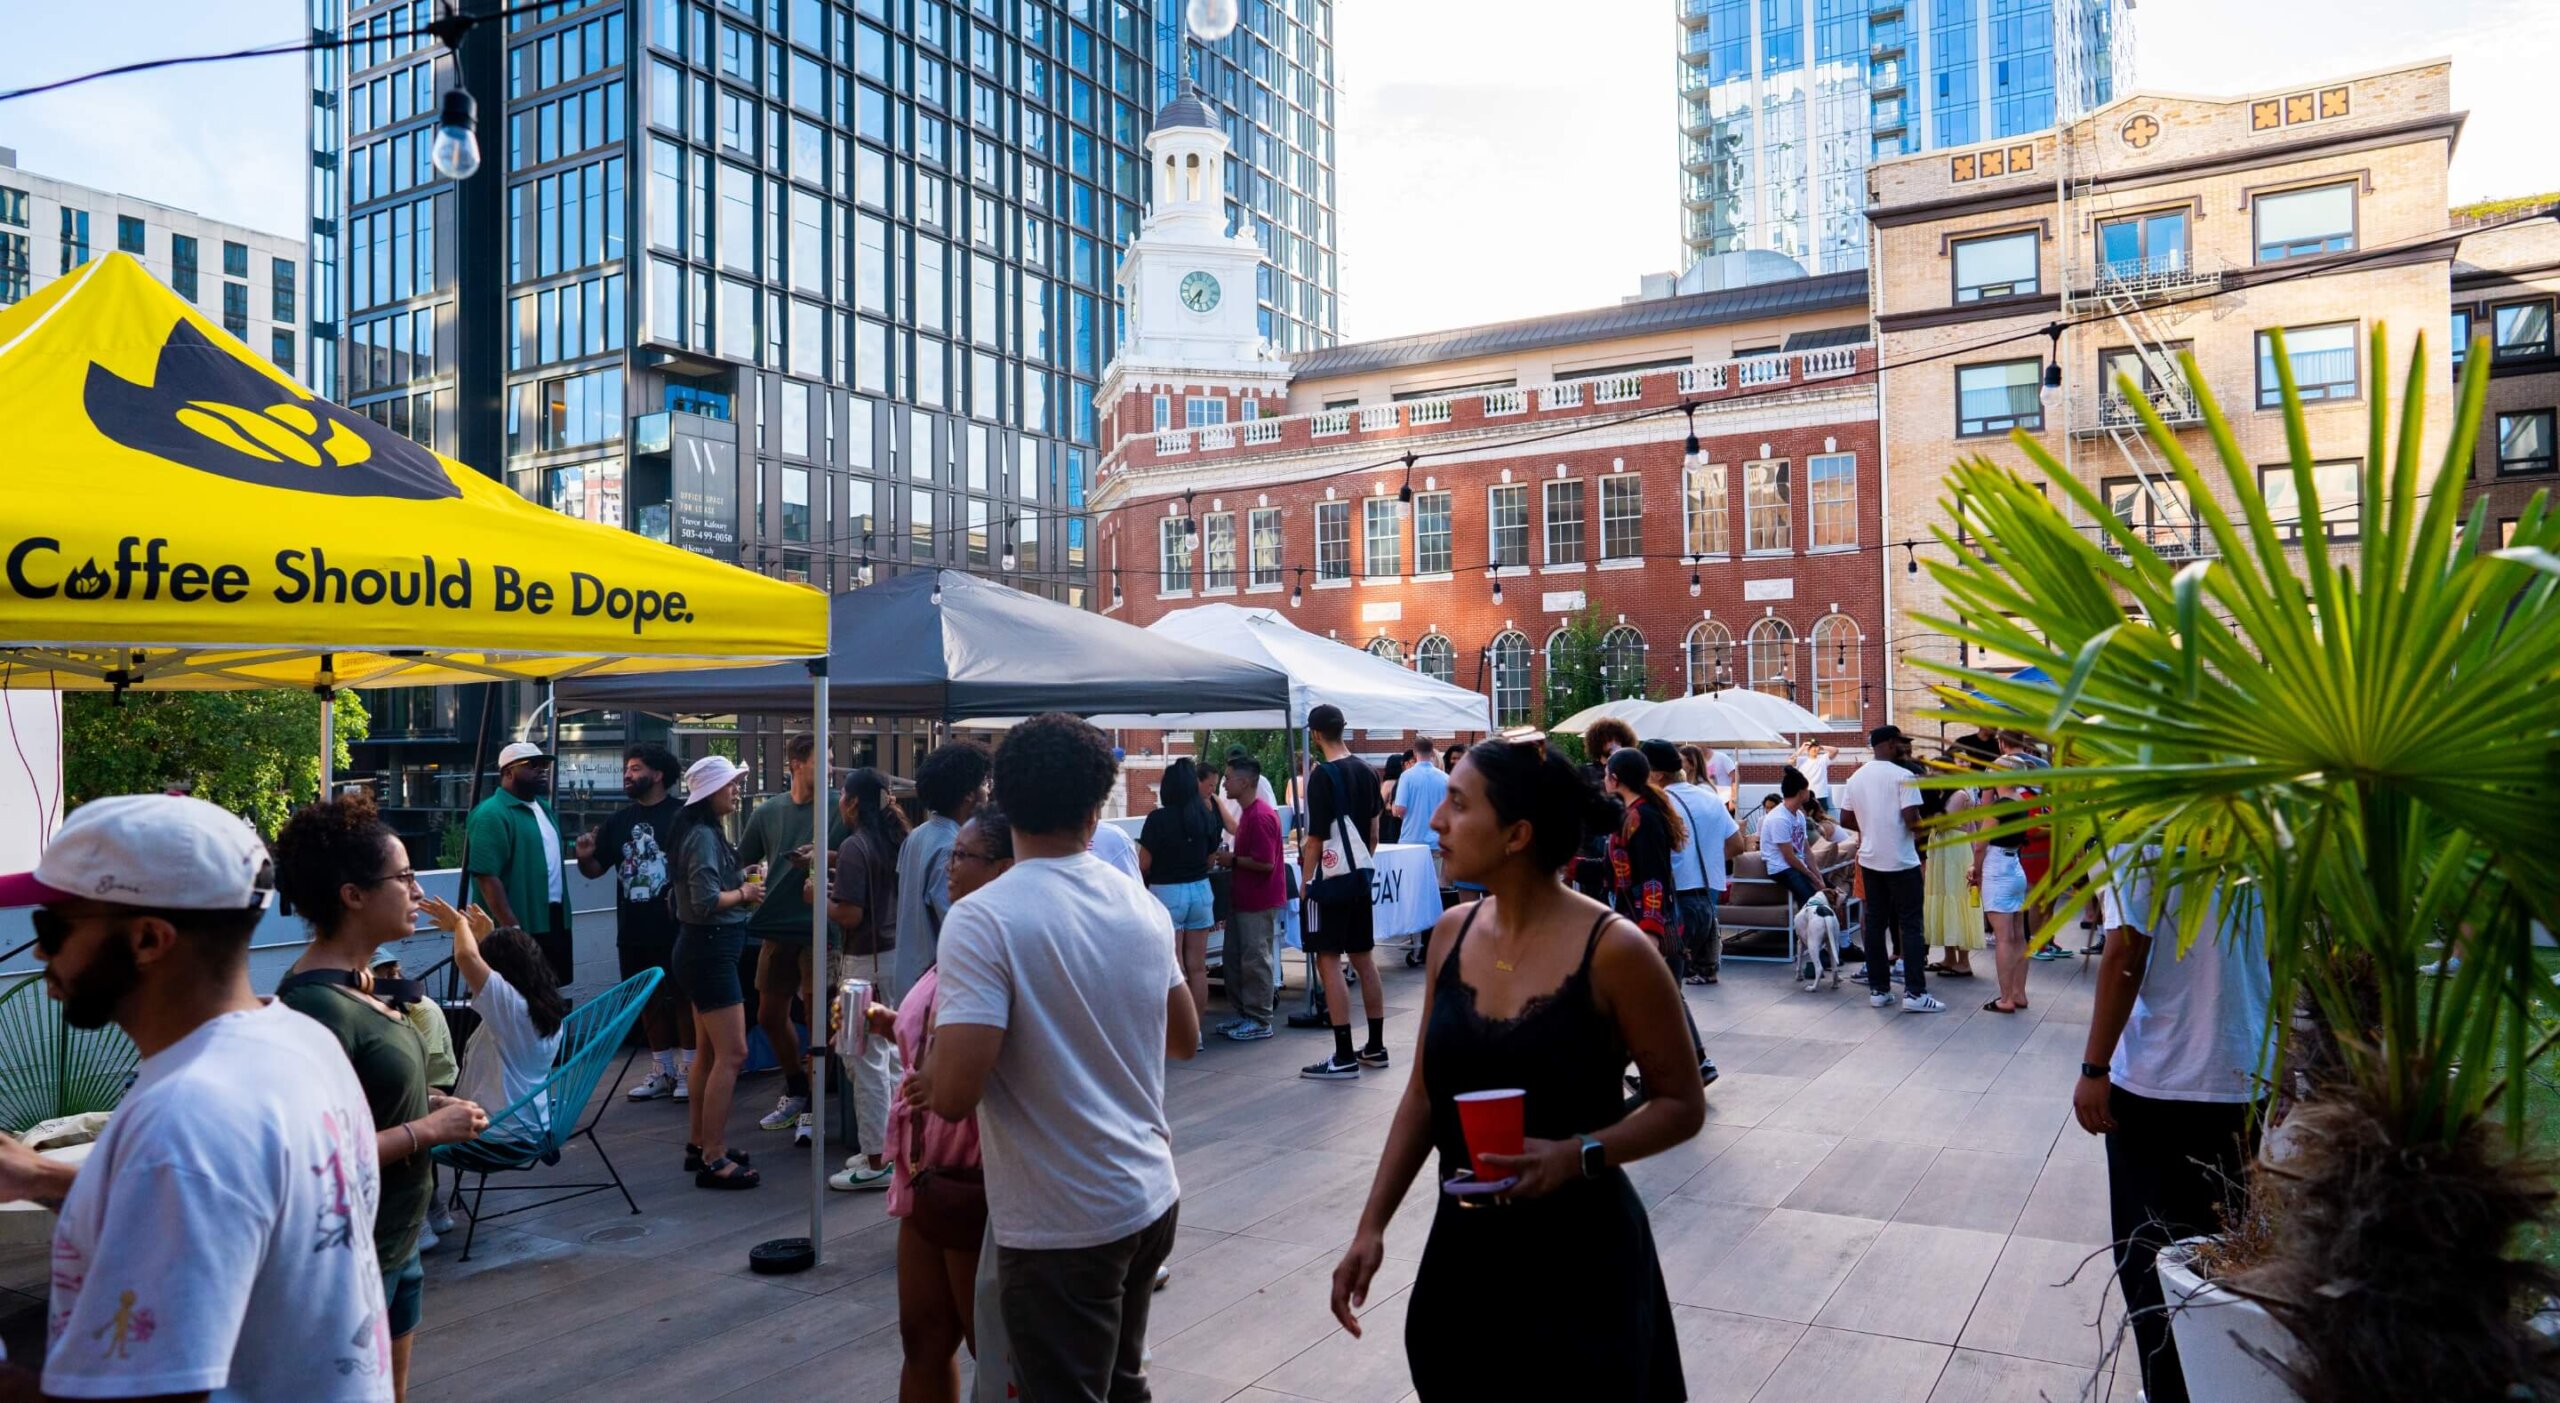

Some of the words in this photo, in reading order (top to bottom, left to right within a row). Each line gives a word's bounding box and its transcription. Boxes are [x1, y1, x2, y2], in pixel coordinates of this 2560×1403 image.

[680, 490, 702, 502] OFFICE
[704, 495, 724, 506] SPACE
[680, 502, 693, 512] FOR
[695, 504, 715, 515] LEASE
[681, 516, 701, 526] Trevor
[681, 528, 733, 543] 503-499-0050
[6, 536, 250, 603] Coffee
[273, 547, 472, 609] Should
[494, 565, 554, 615] Be
[570, 571, 694, 634] Dope.
